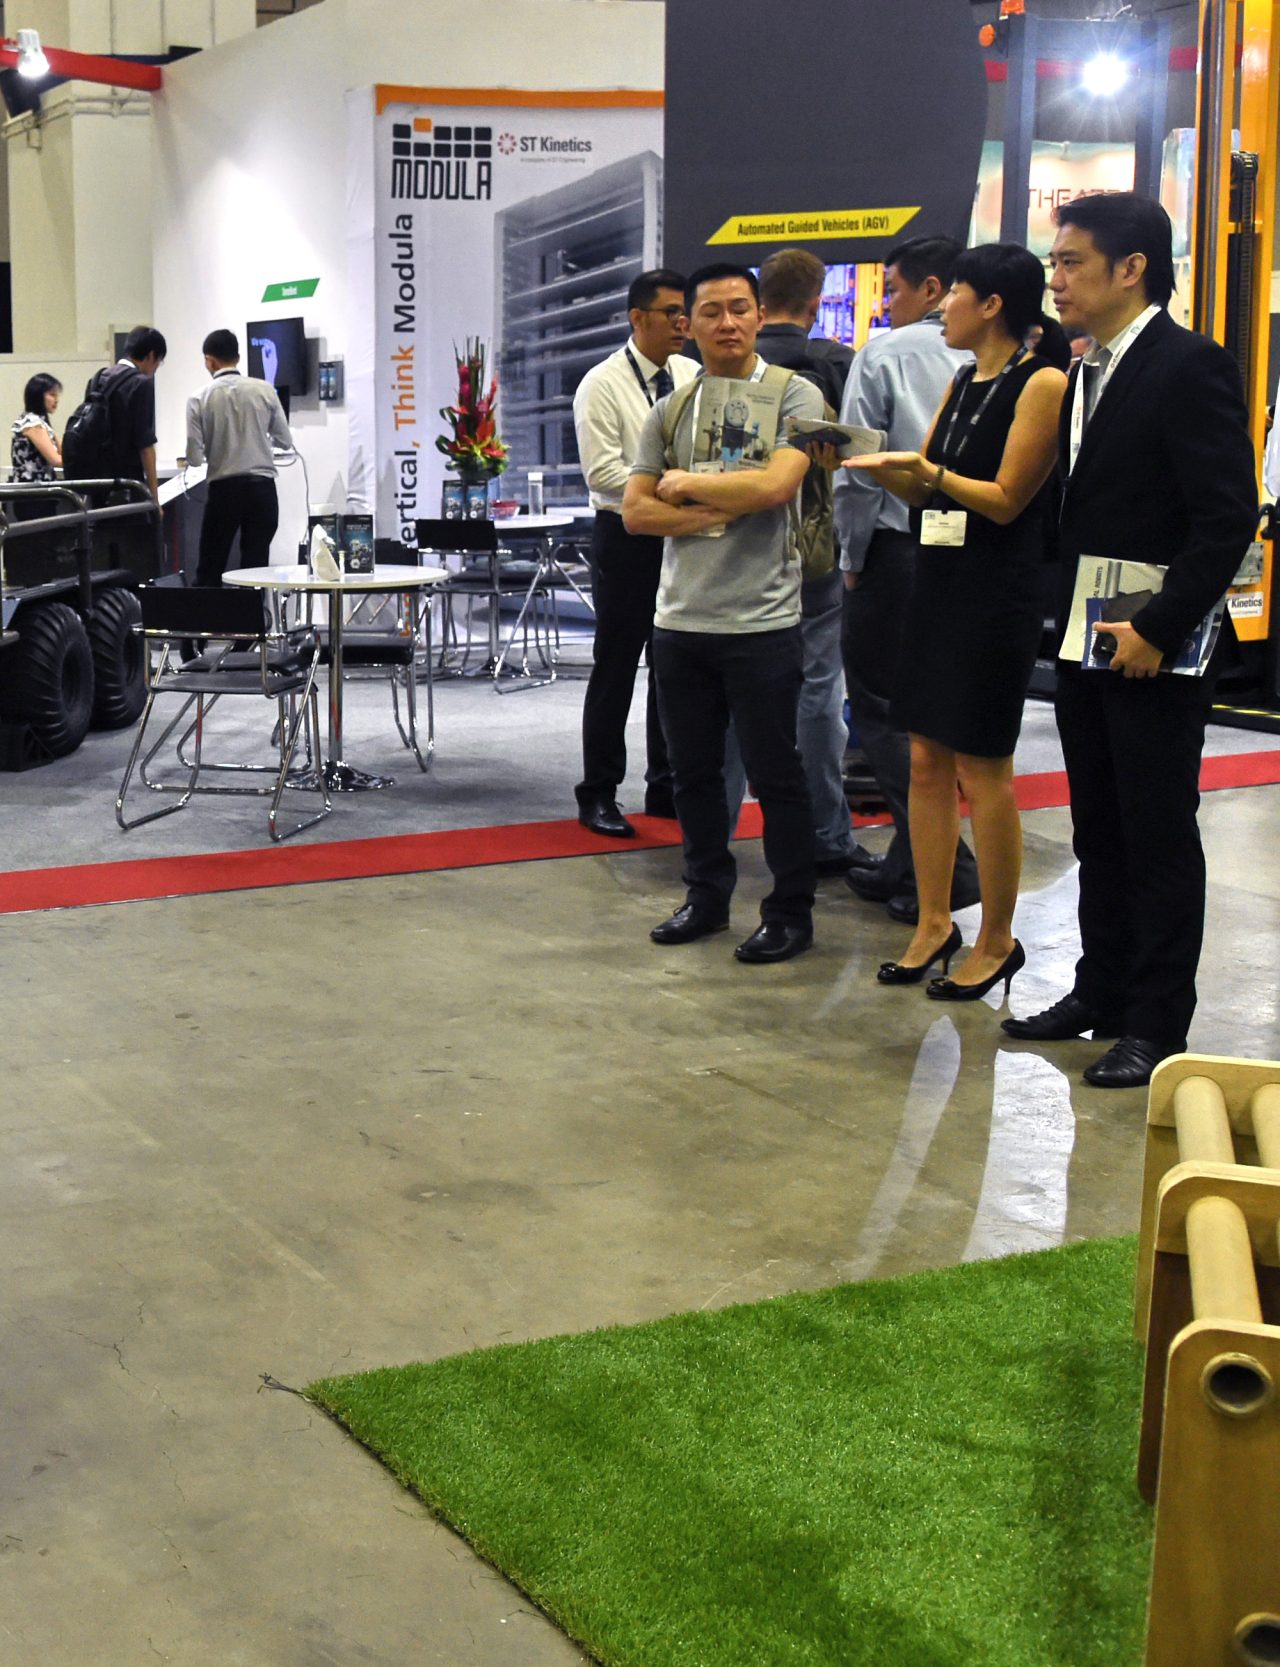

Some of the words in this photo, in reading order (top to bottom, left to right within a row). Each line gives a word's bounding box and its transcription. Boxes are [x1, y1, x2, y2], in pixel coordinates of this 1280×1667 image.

[520, 137, 536, 152] ST
[540, 136, 592, 153] Kinetics
[391, 158, 492, 200] MODULA
[737, 222, 785, 236] Automated
[787, 219, 820, 234] Guided
[822, 218, 860, 231] Vehicles
[862, 216, 890, 231] (AGV)
[388, 213, 416, 334] Modula
[391, 344, 417, 431] Think
[394, 438, 421, 549] ertical,
[1231, 597, 1263, 608] Kinetics
